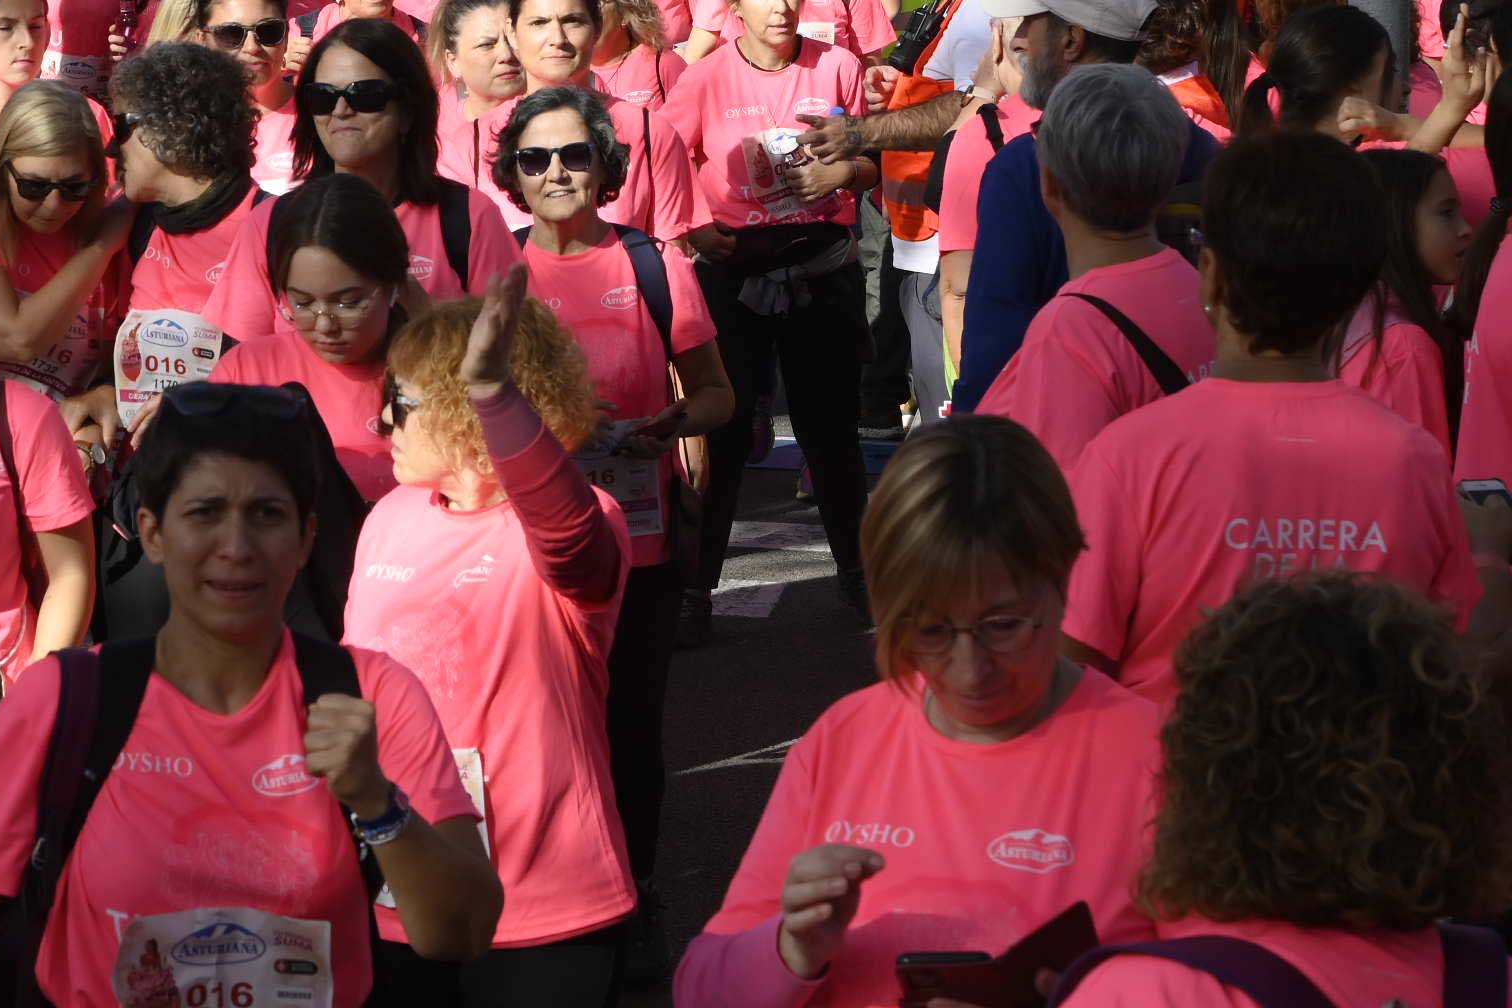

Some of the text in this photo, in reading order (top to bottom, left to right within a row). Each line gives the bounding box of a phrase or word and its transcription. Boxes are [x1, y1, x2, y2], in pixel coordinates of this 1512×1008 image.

[726, 105, 765, 119] OYSHO
[143, 328, 186, 343] ASTURIANA
[145, 354, 187, 375] 016
[1224, 517, 1388, 552] CARRERA
[825, 822, 915, 850] OYSHO
[995, 842, 1070, 864] ASTURIANA
[180, 941, 259, 957] ASTURIANA
[186, 981, 254, 1008] 016
